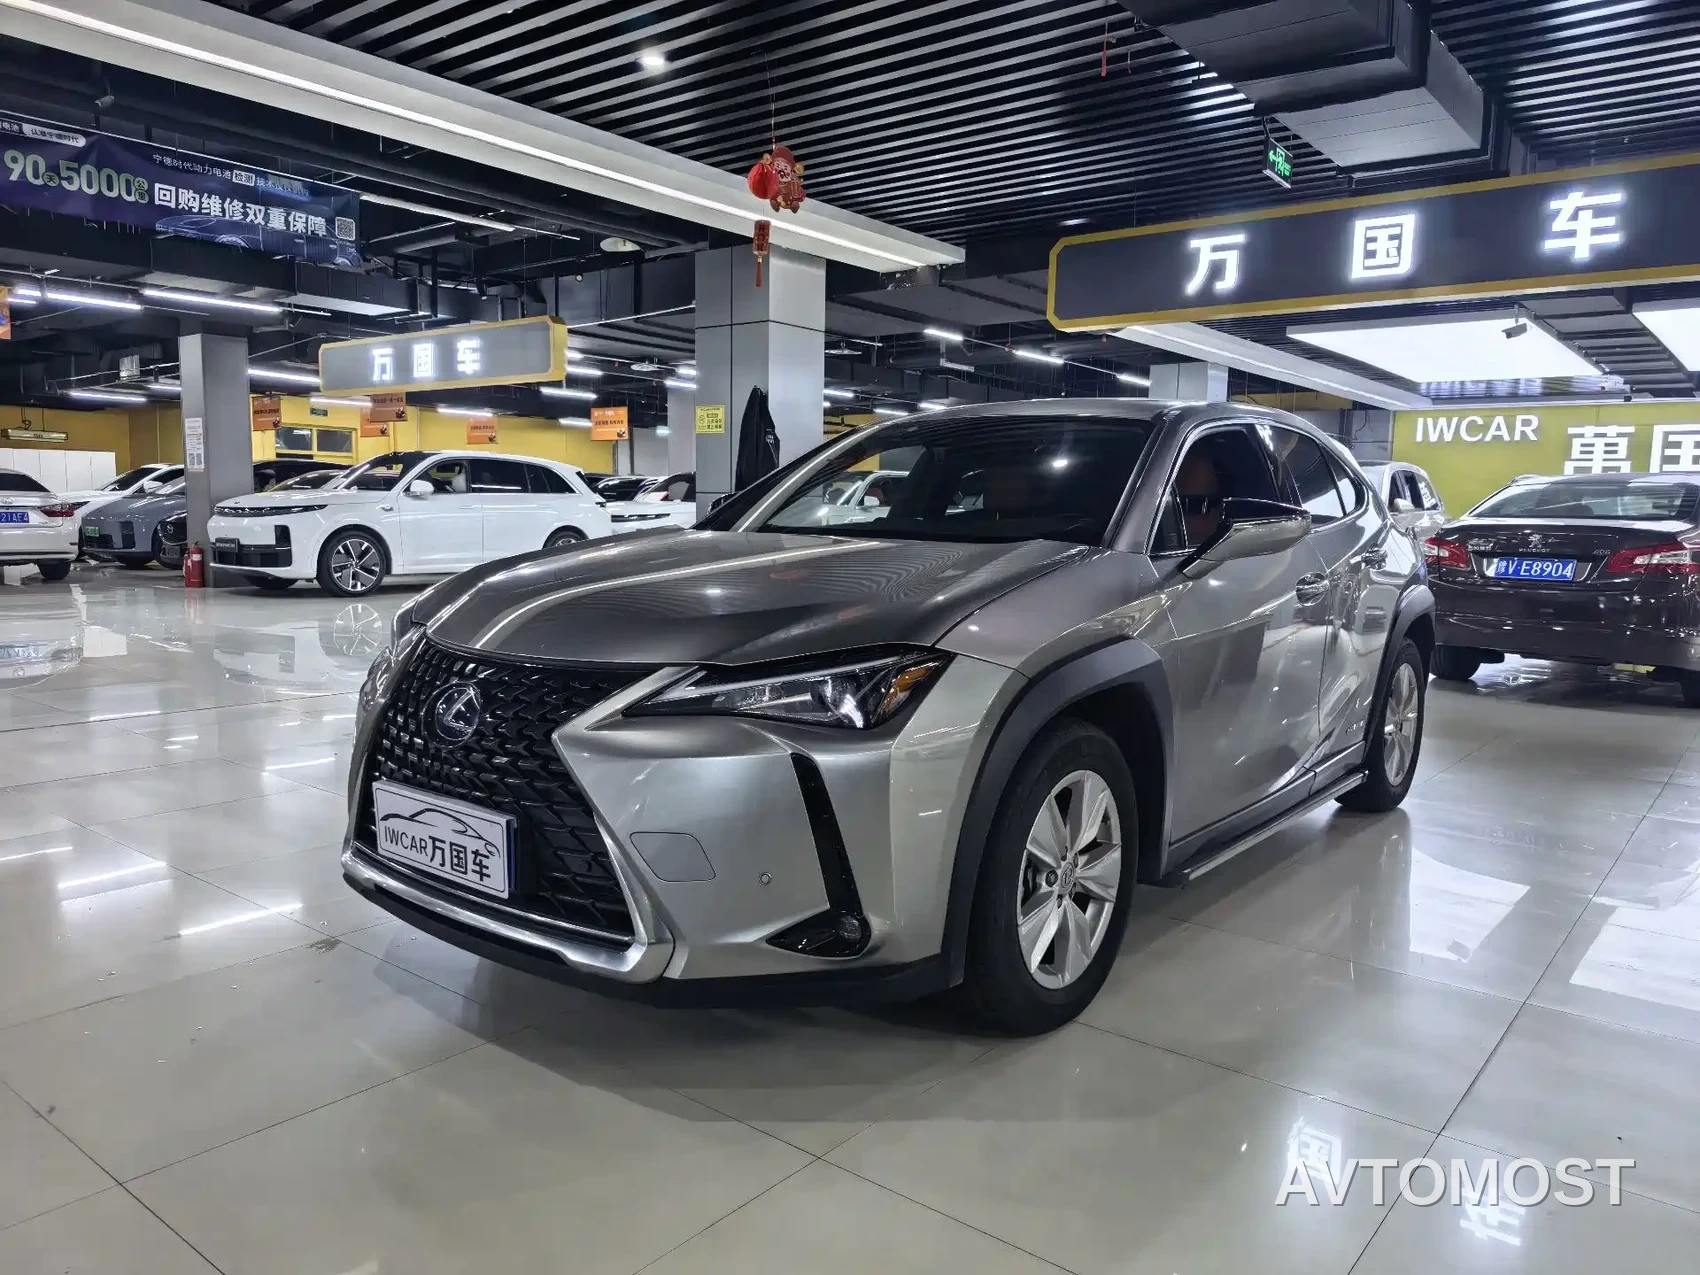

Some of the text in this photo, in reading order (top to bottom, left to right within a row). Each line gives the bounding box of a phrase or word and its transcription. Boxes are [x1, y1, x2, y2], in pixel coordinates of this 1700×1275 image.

[154, 183, 327, 236] 回购维修双重保障
[1185, 191, 1624, 296] 万国车
[371, 338, 481, 382] 万国车
[1415, 414, 1540, 443] IWCAR
